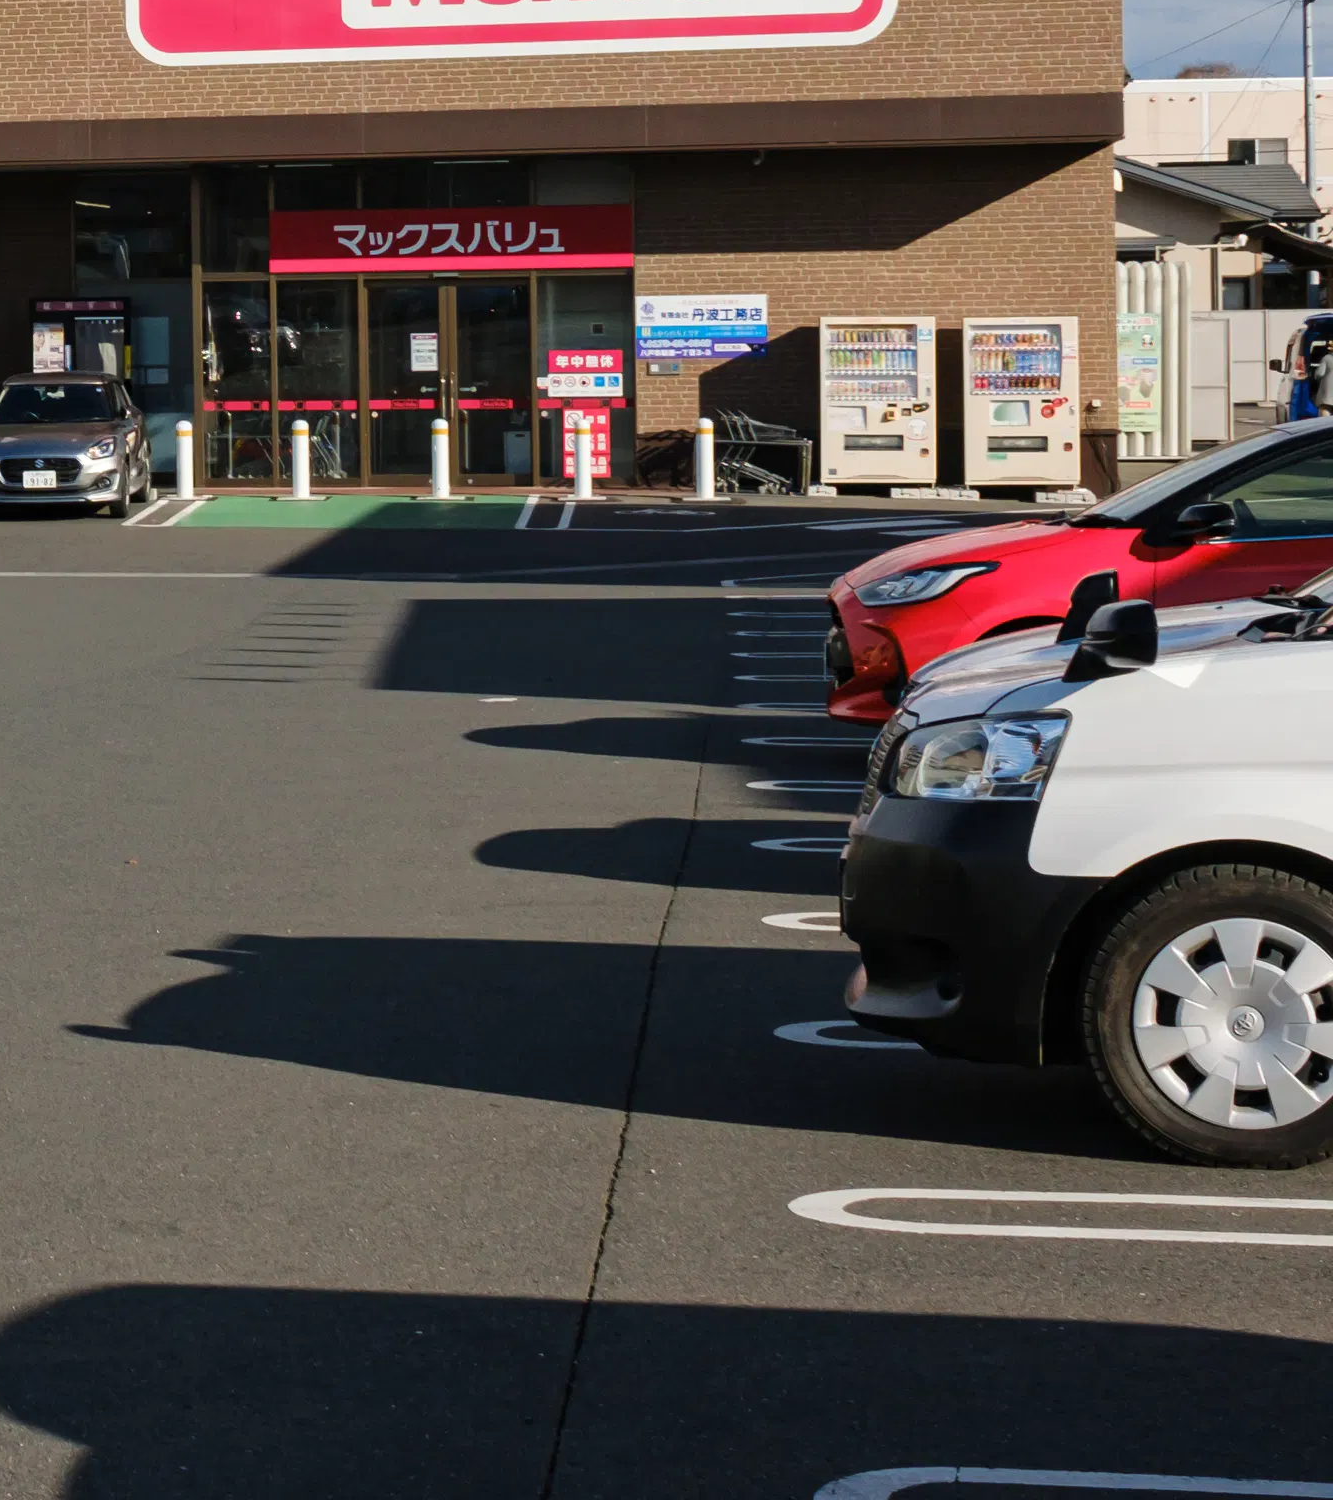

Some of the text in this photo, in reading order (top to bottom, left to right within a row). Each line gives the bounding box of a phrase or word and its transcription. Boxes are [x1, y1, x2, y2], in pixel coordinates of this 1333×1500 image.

[333, 220, 565, 256] マックスバリュ
[555, 355, 614, 368] 年中無休
